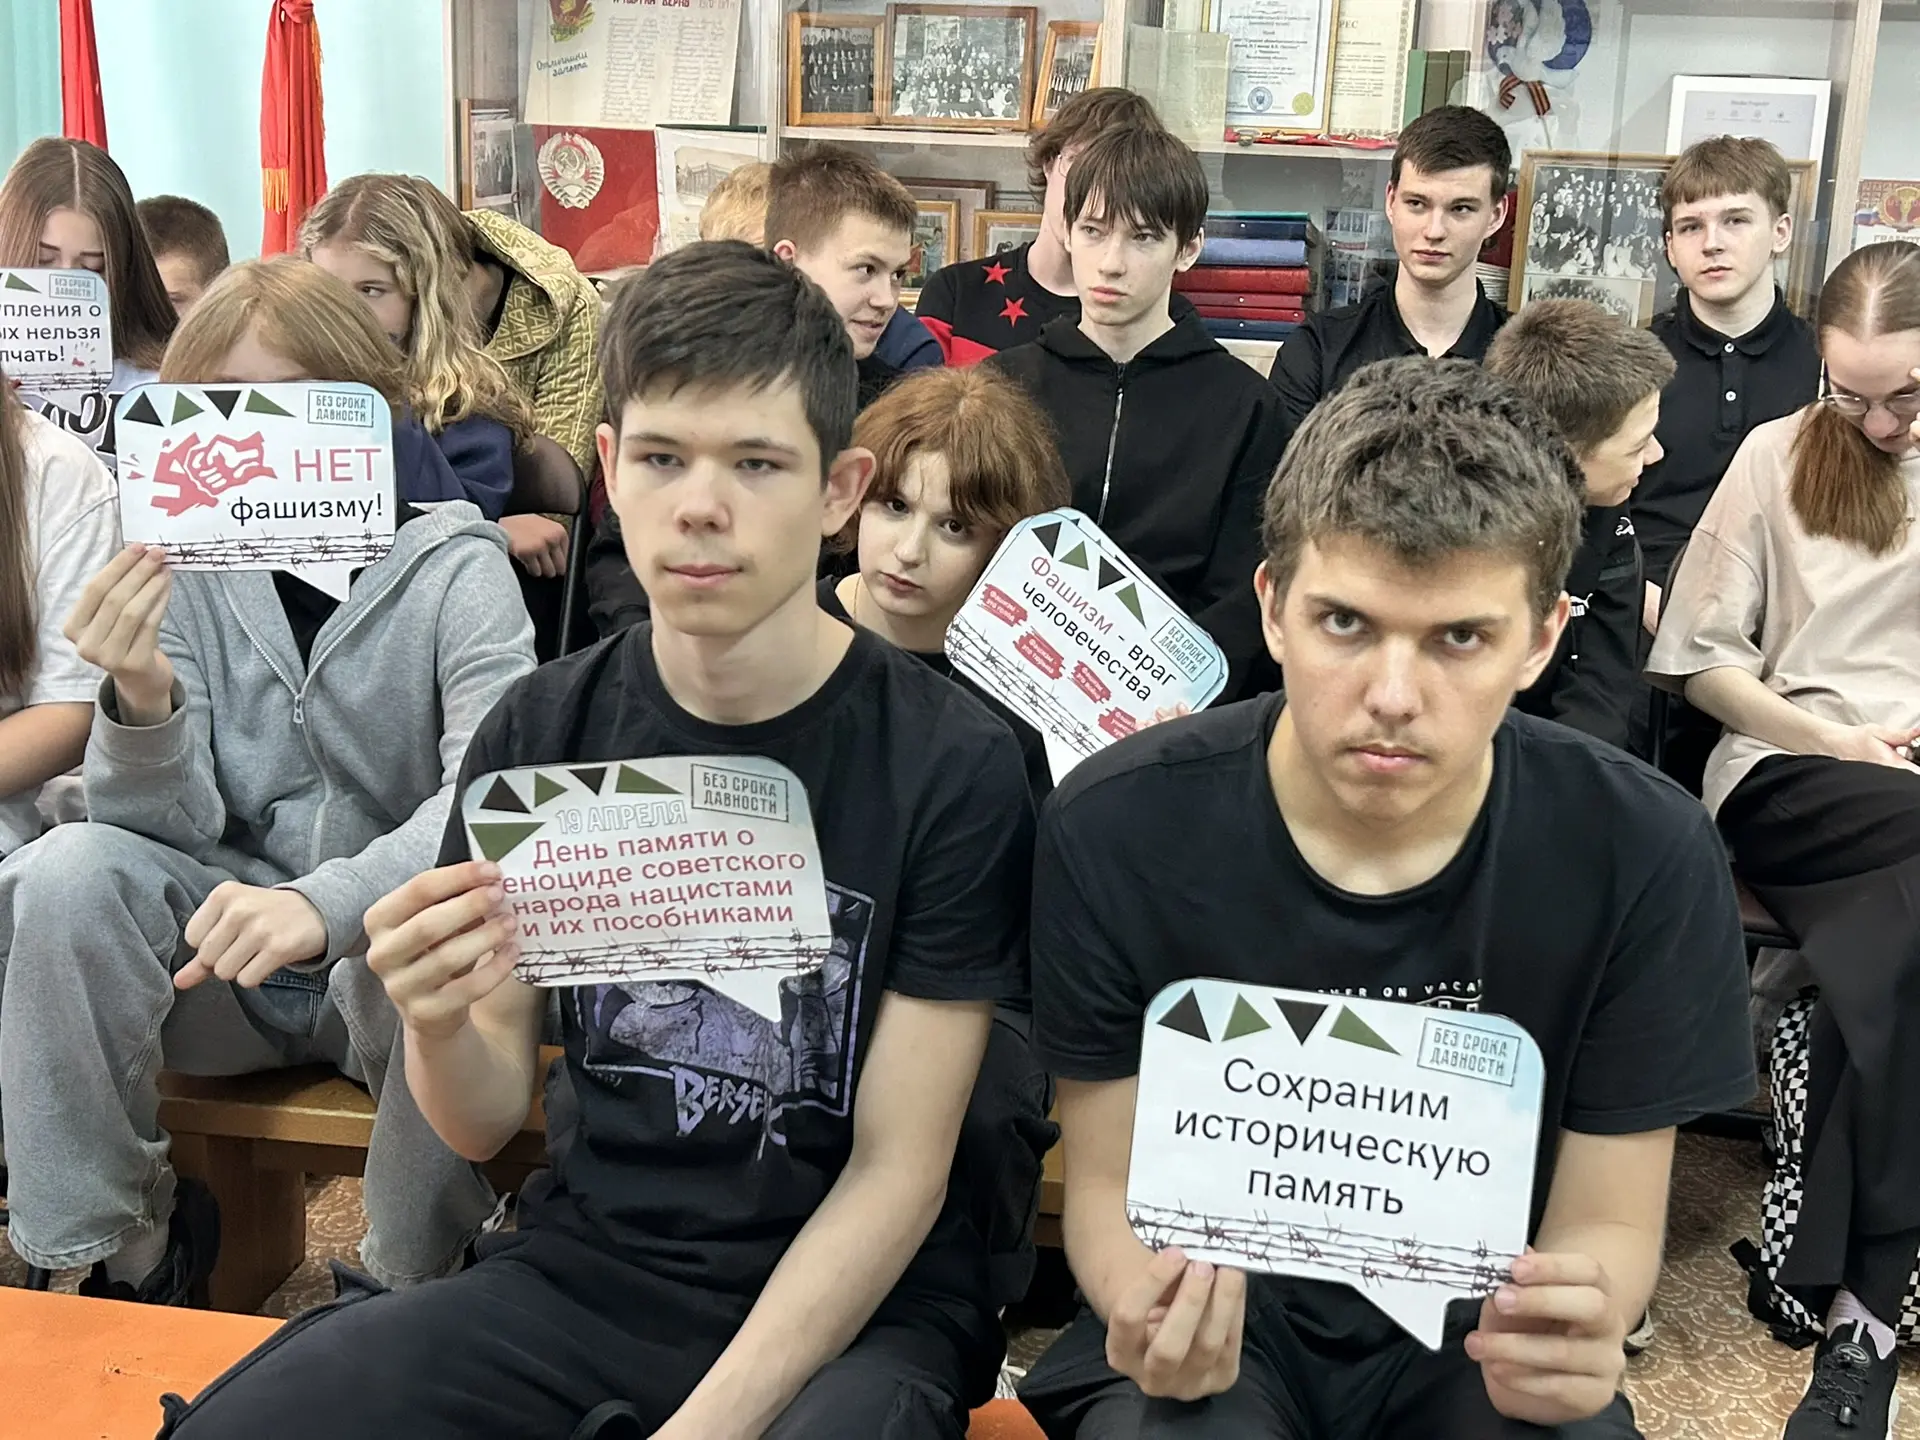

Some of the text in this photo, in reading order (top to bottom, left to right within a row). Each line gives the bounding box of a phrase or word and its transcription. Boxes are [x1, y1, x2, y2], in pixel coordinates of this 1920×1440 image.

[1339, 20, 1358, 28] РЕС
[54, 277, 91, 288] БЕЗ СРОКА
[55, 286, 91, 298] ДАВНОСТИ
[0, 304, 101, 317] пления о
[27, 326, 100, 340] нельзя
[315, 394, 366, 411] БЕЗ СРОКА
[315, 408, 367, 423] ДАВНОСТИ
[294, 447, 383, 482] НЕТ
[230, 492, 383, 526] фашизму!
[1031, 556, 1114, 635] Фашизм
[1128, 645, 1177, 686] враг
[1023, 581, 1152, 702] человечества
[1158, 635, 1198, 674] ДАВНОСТИ
[1167, 625, 1207, 665] БЕЗ СРОКА
[702, 771, 778, 797] БЕЗ СРОКА
[556, 799, 688, 835] 19 АПРЕЛЯ
[703, 789, 778, 814] ДАВНОСТИ
[533, 829, 755, 869] День памяти о
[503, 851, 806, 895] еноциде советского
[512, 878, 794, 918] народа нацистами
[522, 903, 794, 937] и их пособниками
[1383, 987, 1408, 997] ON
[1432, 1027, 1509, 1059] БЕЗ СРОКА
[1428, 1046, 1506, 1077] ДАВНОСТИ
[1223, 1057, 1450, 1121] Сохраним
[1174, 1108, 1491, 1182] историческую
[1247, 1167, 1404, 1215] память
